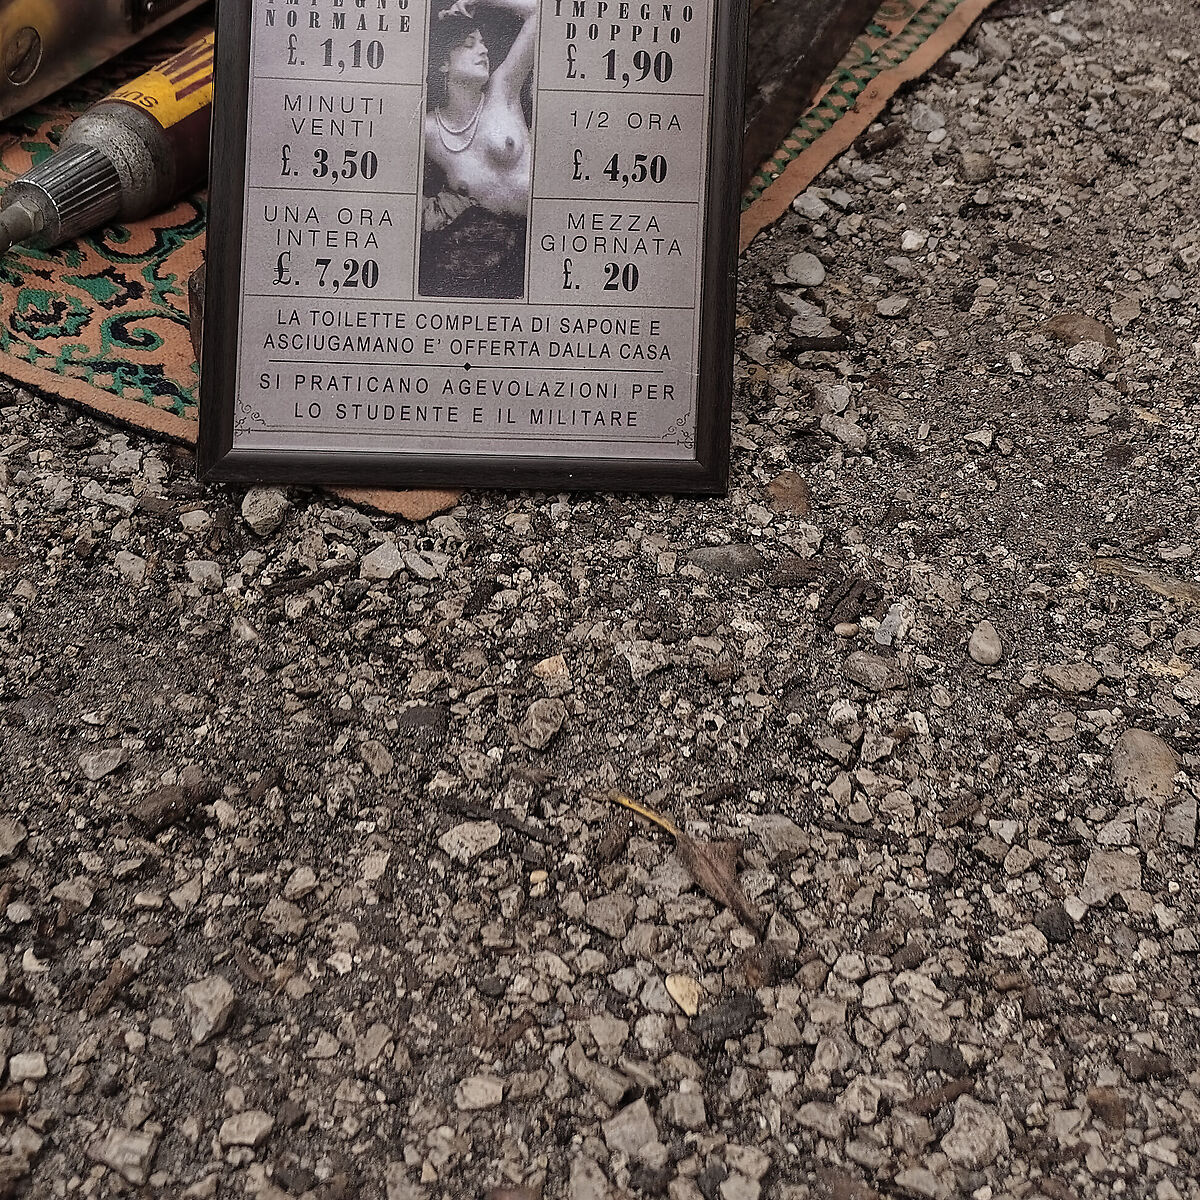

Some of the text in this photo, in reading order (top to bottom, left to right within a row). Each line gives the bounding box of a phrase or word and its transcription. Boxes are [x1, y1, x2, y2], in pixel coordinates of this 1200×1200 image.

[265, 8, 411, 33] NORMALE
[554, 0, 693, 23] IMPEGNO
[565, 22, 681, 45] DOPPIO
[319, 37, 385, 75] 1,10
[601, 48, 673, 89] 1,90
[283, 94, 383, 115] MINUTI
[291, 117, 373, 138] VENTI
[570, 110, 682, 132] 1/2 ORA
[312, 148, 379, 186] 3,50
[602, 152, 668, 189] 4,50
[264, 205, 393, 227] UNA ORA
[567, 212, 661, 233] MEZZA
[276, 228, 379, 249] INTERA
[540, 234, 682, 257] GIORNATA
[314, 257, 380, 295] 7,20
[603, 262, 640, 293] 20
[277, 309, 661, 336] LA TOILETTE COMPLETA DI SAPONE E
[263, 332, 414, 354] ASCIUGAMANO
[449, 338, 541, 357] OFFERTA
[548, 341, 611, 359] DALLA
[619, 343, 672, 361] CASA
[259, 372, 675, 401] SI PRATICANO AGEVOLAZIONI PER
[294, 402, 638, 427] LO STUDENTE E IL MILITARE
